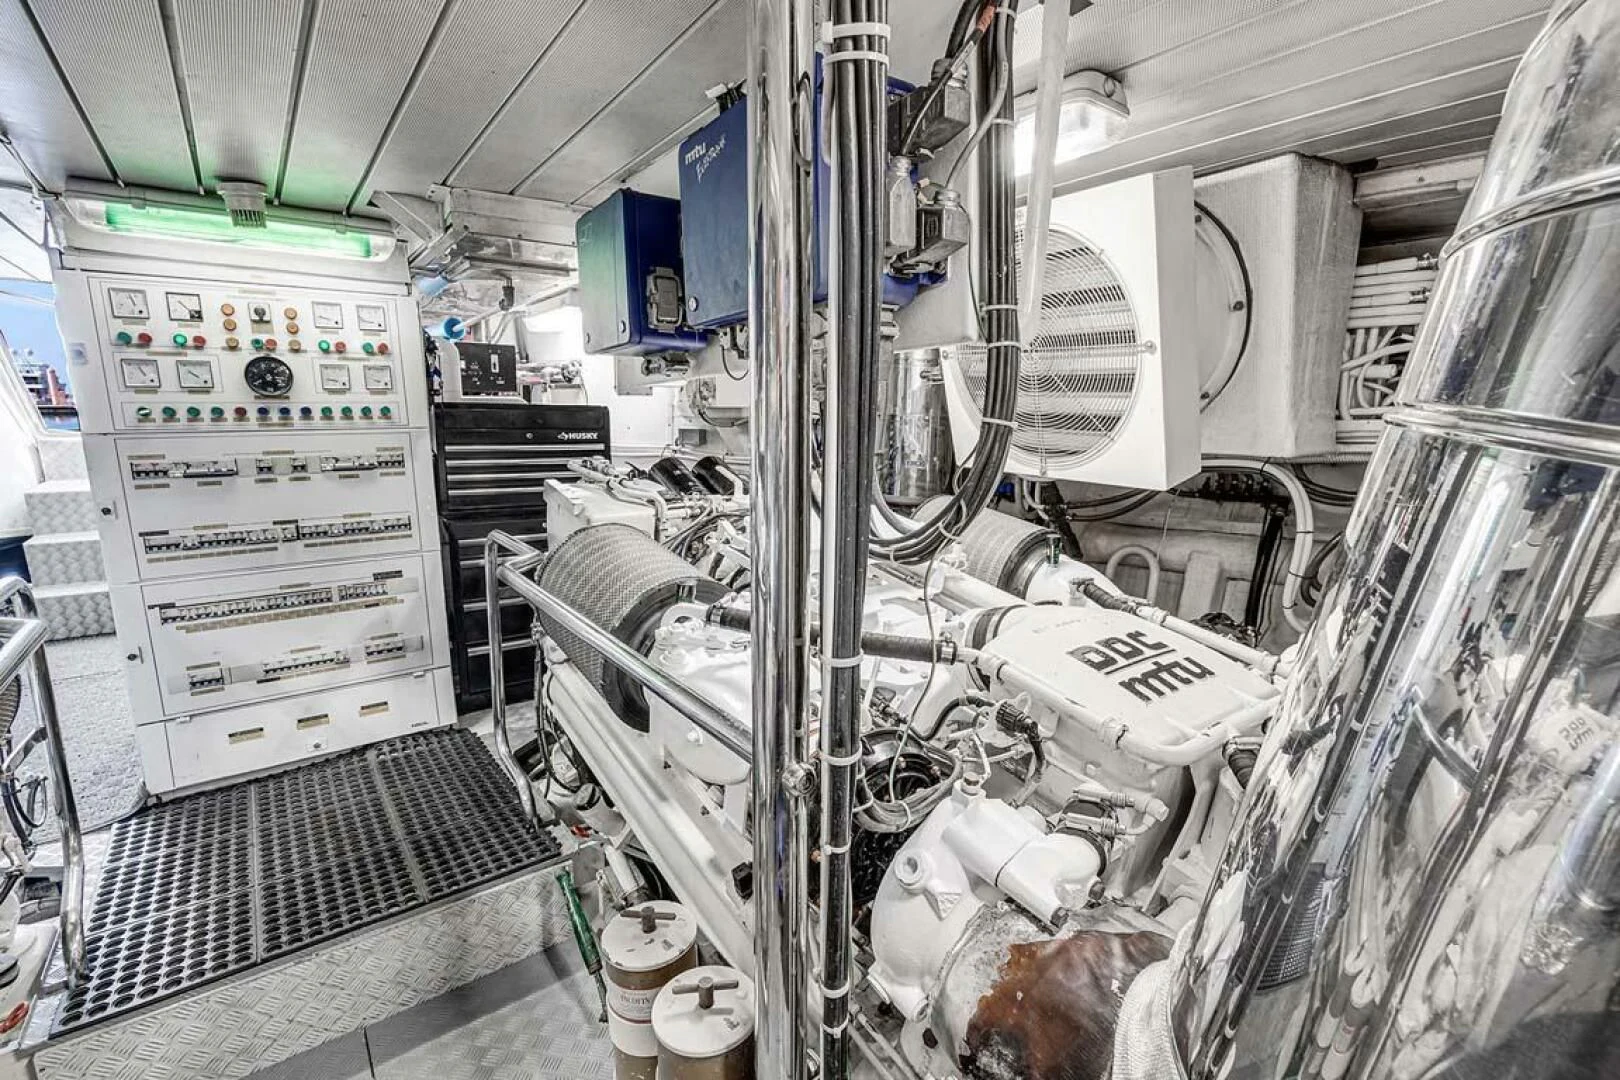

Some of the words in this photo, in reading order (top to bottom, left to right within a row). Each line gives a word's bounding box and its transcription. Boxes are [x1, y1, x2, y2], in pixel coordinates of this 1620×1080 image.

[685, 142, 706, 165] mtu
[569, 432, 598, 440] HUSKY
[1066, 630, 1168, 672] DDC
[1118, 656, 1215, 702] mtu
